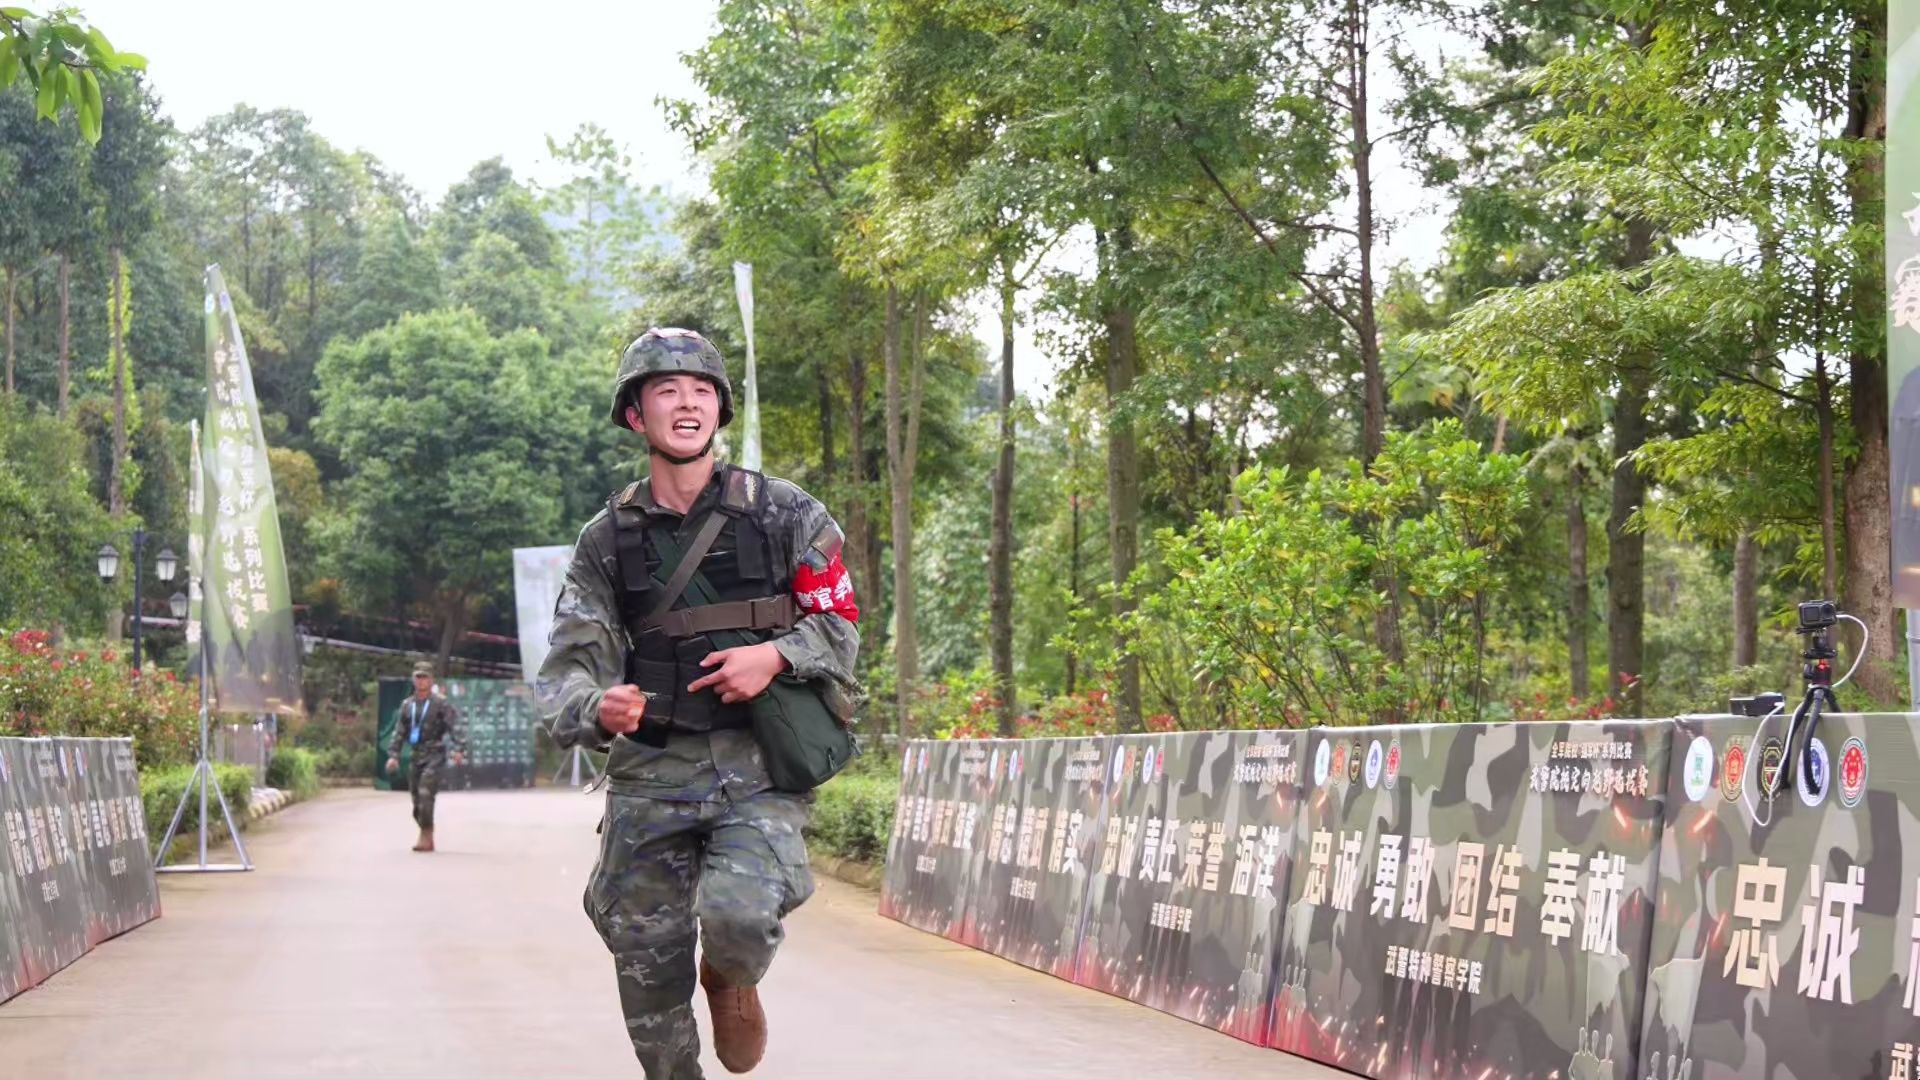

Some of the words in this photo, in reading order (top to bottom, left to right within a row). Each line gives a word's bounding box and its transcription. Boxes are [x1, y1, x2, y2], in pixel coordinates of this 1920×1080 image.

[1101, 814, 1139, 878] 忠诚
[1139, 816, 1180, 883] 责任
[1182, 820, 1226, 891] 荣誉
[1230, 825, 1279, 898] 海洋
[1302, 826, 1363, 912] 忠诚
[1370, 834, 1435, 924] 勇敢
[1449, 841, 1523, 937] 团结
[1540, 848, 1626, 956] 奉献
[1384, 945, 1482, 994] 武警特种警察学院
[1722, 857, 1865, 1004] 忠诚
[1888, 1042, 1920, 1080] 武
